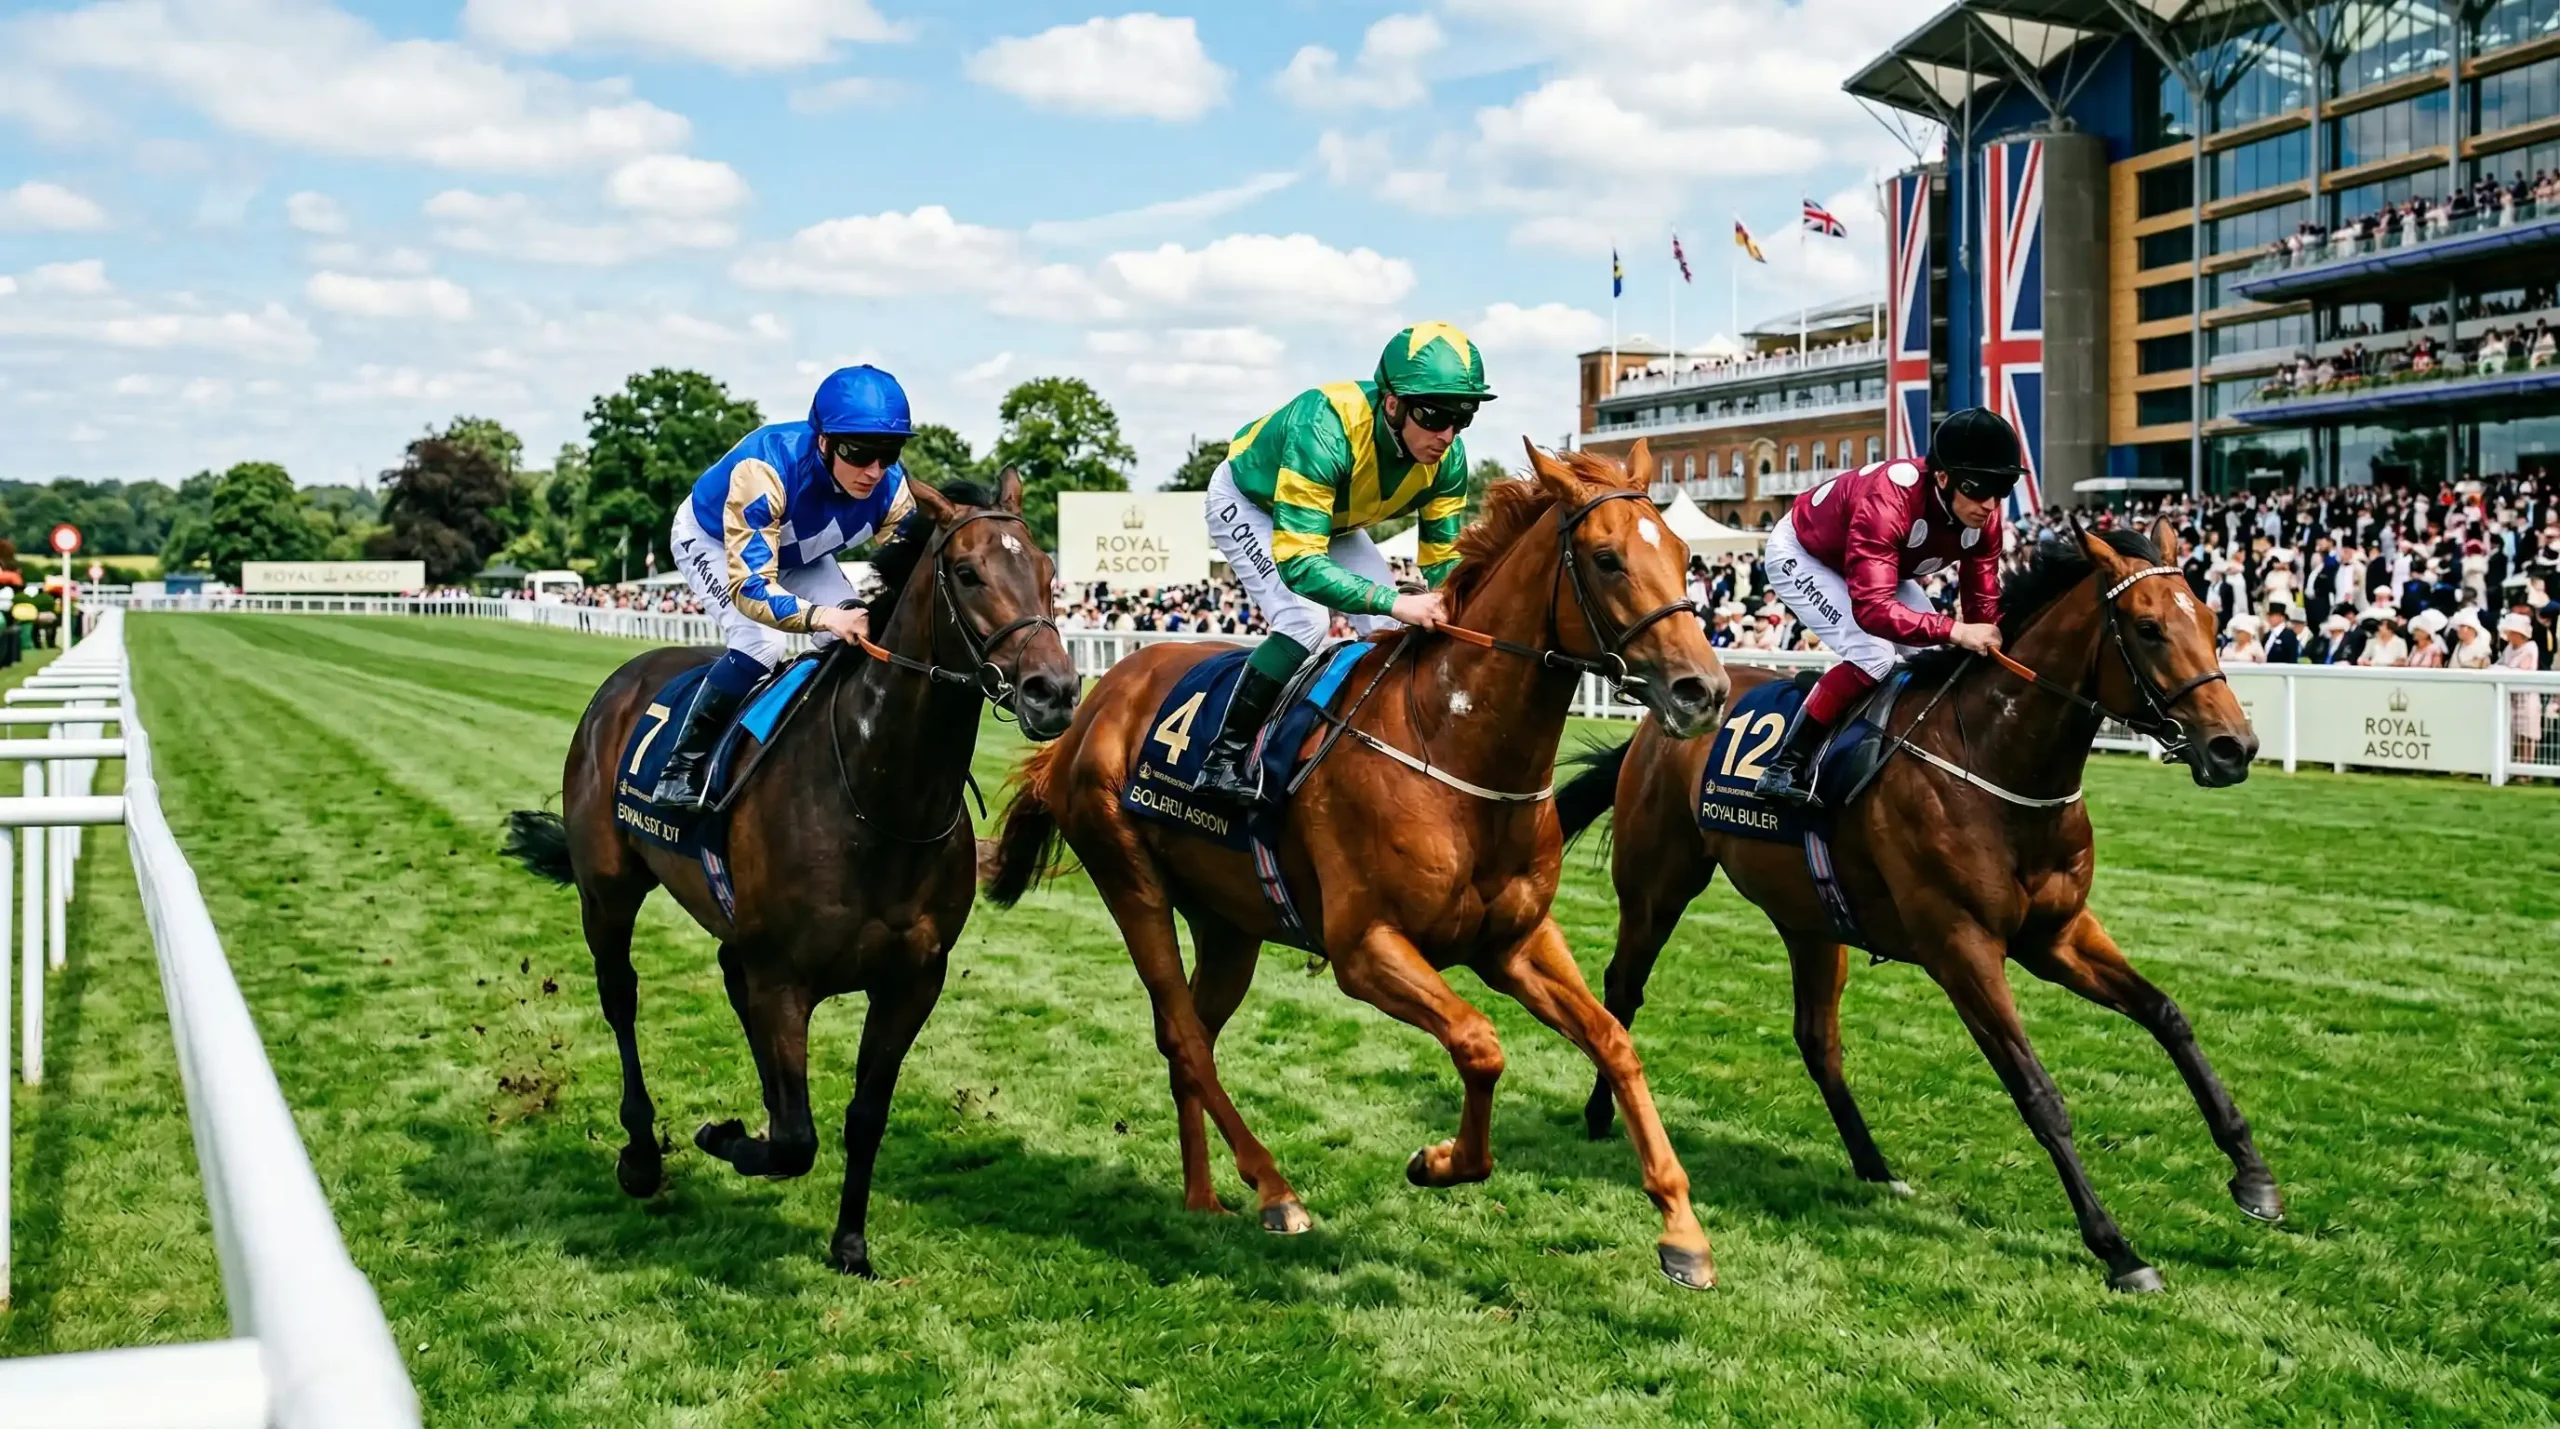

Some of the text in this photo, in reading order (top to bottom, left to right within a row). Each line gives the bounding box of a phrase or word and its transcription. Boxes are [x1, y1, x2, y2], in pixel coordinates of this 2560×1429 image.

[1096, 536, 1169, 552] ROYAL
[1096, 556, 1169, 572] ASCOT
[262, 570, 400, 583] ROYAL ASCOT
[1153, 691, 1207, 766] 4
[2365, 717, 2431, 737] ROYAL
[628, 702, 671, 776] 7
[1720, 709, 1786, 780] 12
[2364, 740, 2431, 760] ASCOT
[1702, 802, 1779, 830] ROYAL BULER
